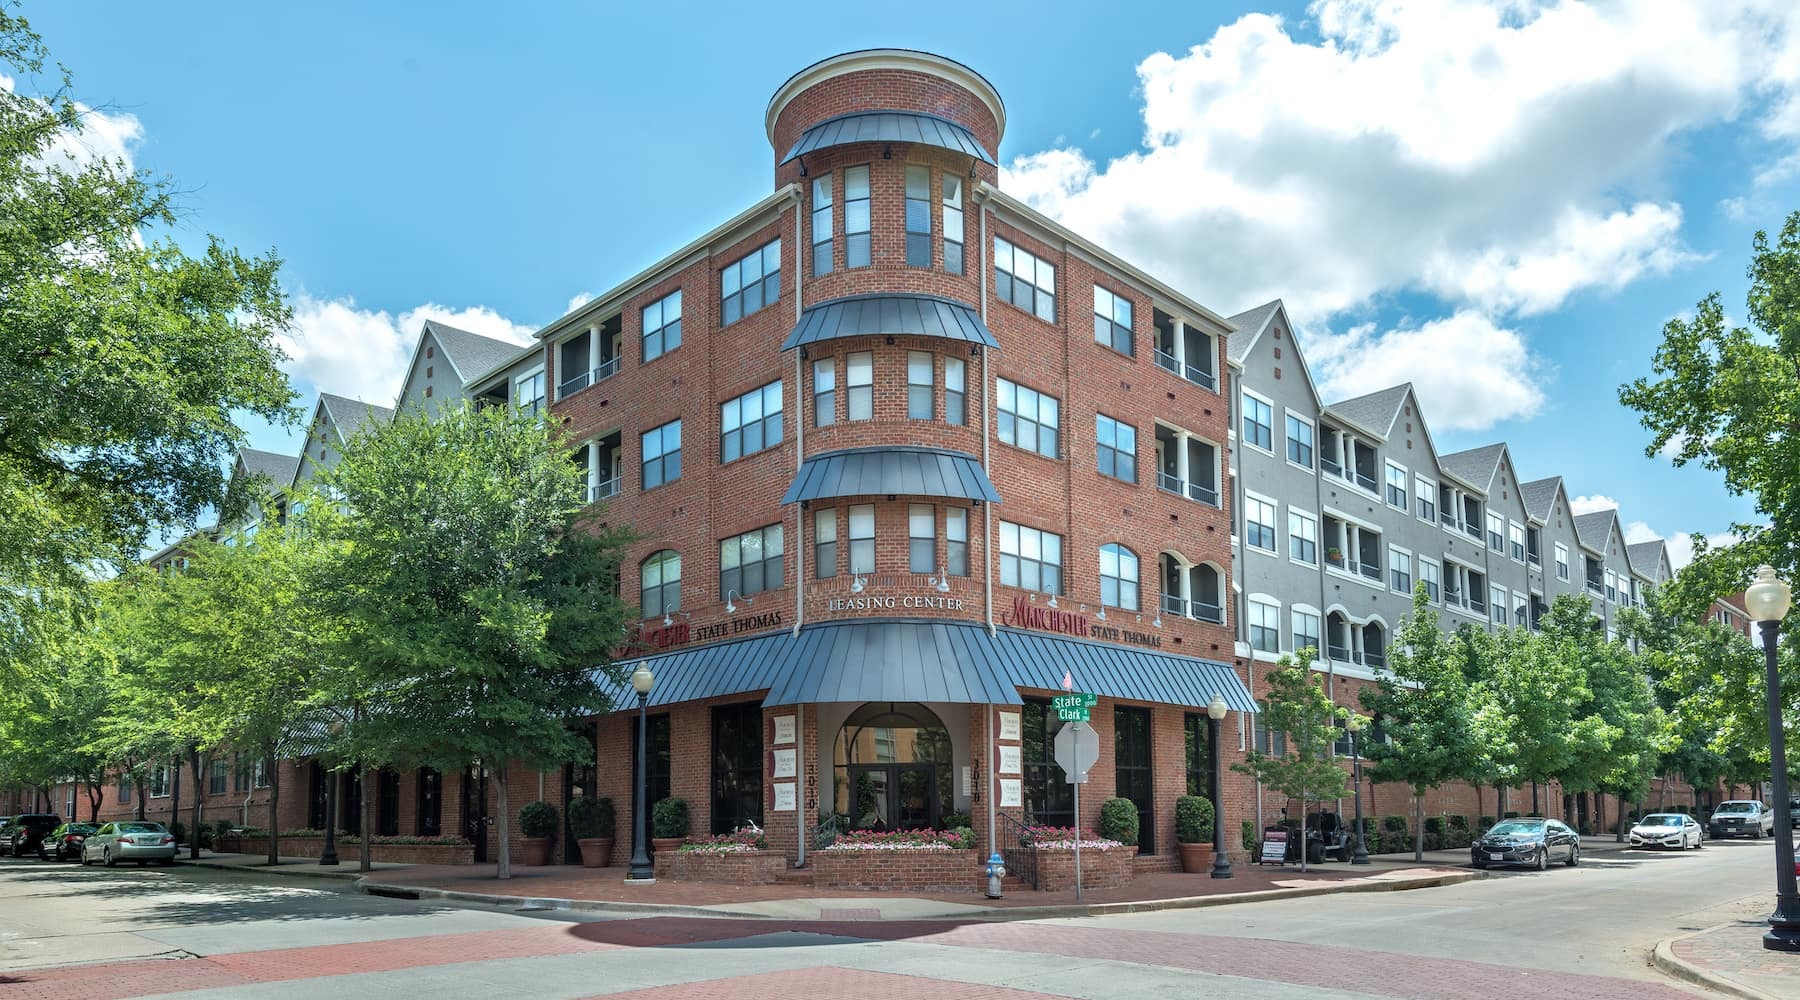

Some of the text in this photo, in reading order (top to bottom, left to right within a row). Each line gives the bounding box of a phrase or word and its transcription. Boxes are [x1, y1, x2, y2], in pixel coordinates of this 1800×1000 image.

[829, 596, 963, 611] LEASING CENTER
[696, 624, 728, 641] STATE
[733, 611, 781, 633] THOMAS
[1090, 625, 1120, 641] STATE
[1122, 629, 1162, 648] THOMAS
[1054, 696, 1082, 708] State
[1059, 708, 1081, 720] Clark
